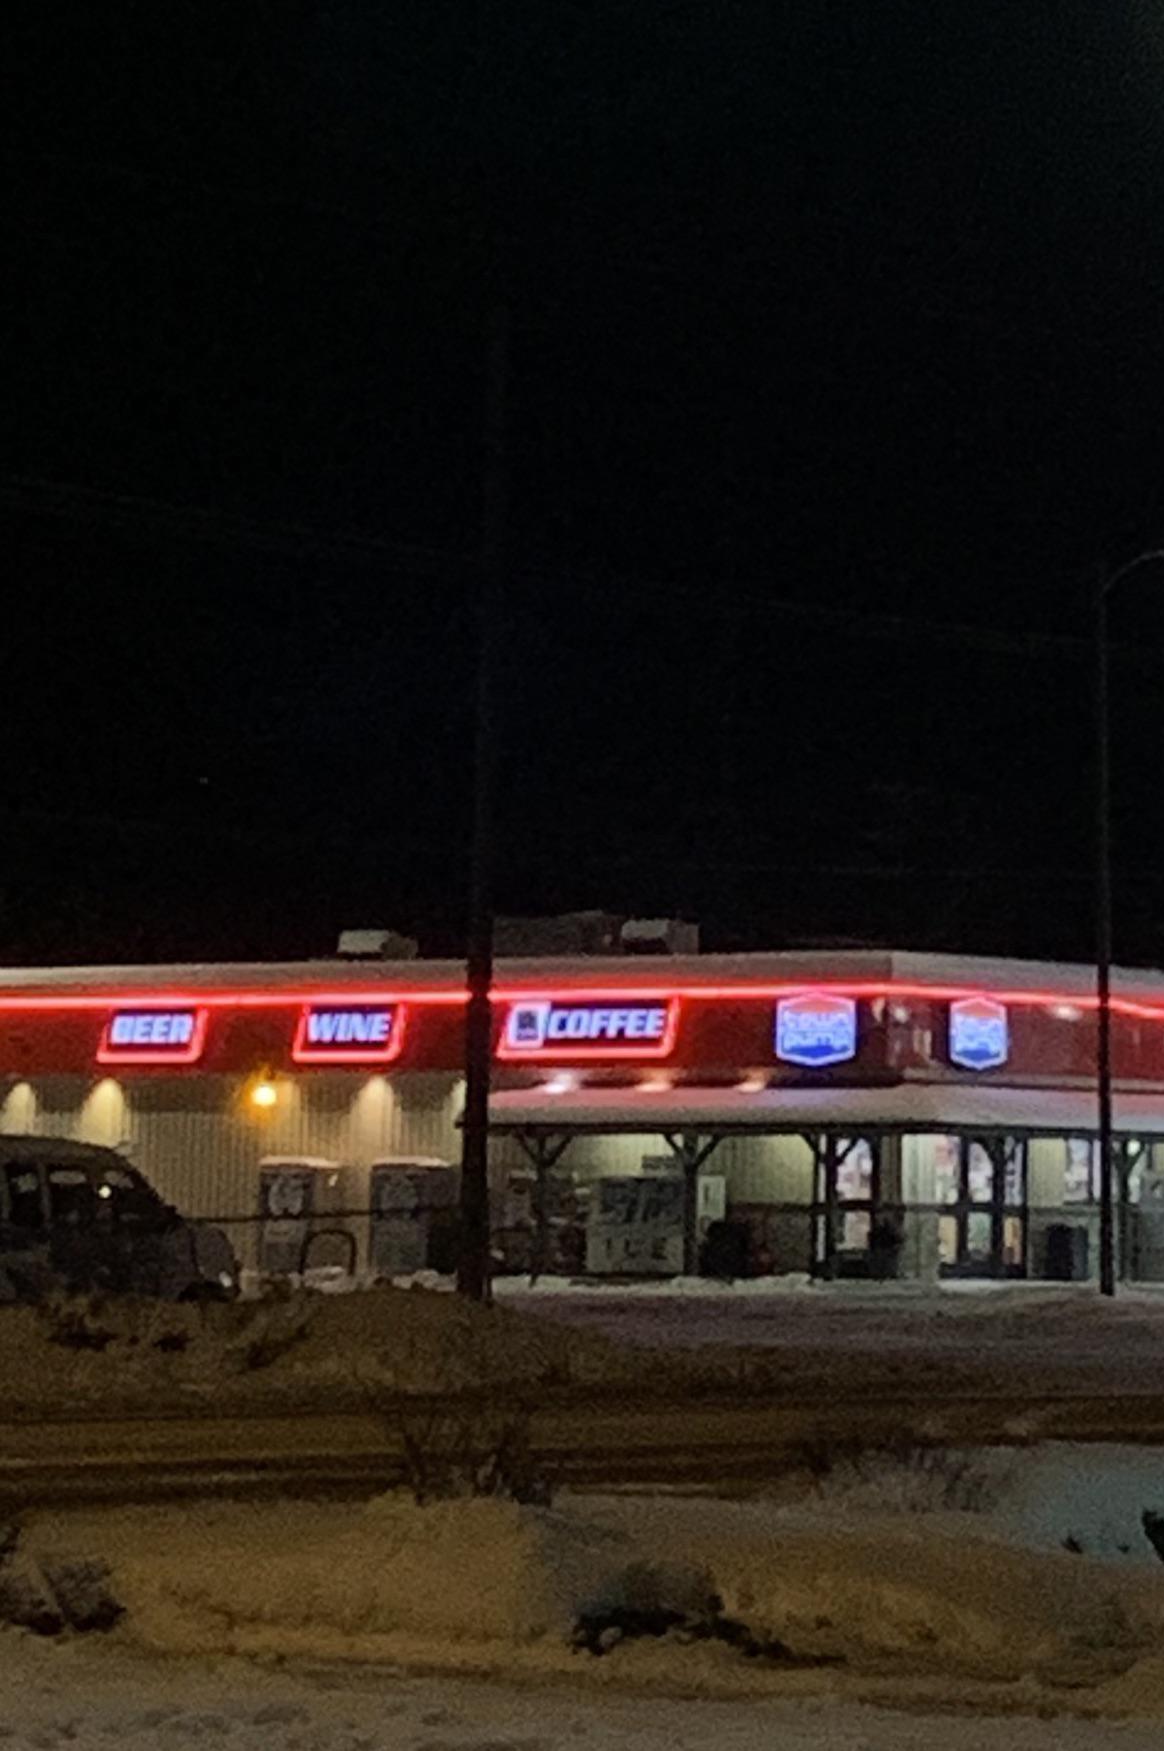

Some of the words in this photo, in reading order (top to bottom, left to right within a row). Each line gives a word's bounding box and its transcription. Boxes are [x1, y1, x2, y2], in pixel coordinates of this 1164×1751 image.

[110, 1014, 194, 1045] BEER
[307, 1012, 392, 1043] WINE
[547, 1008, 667, 1039] COFFEE
